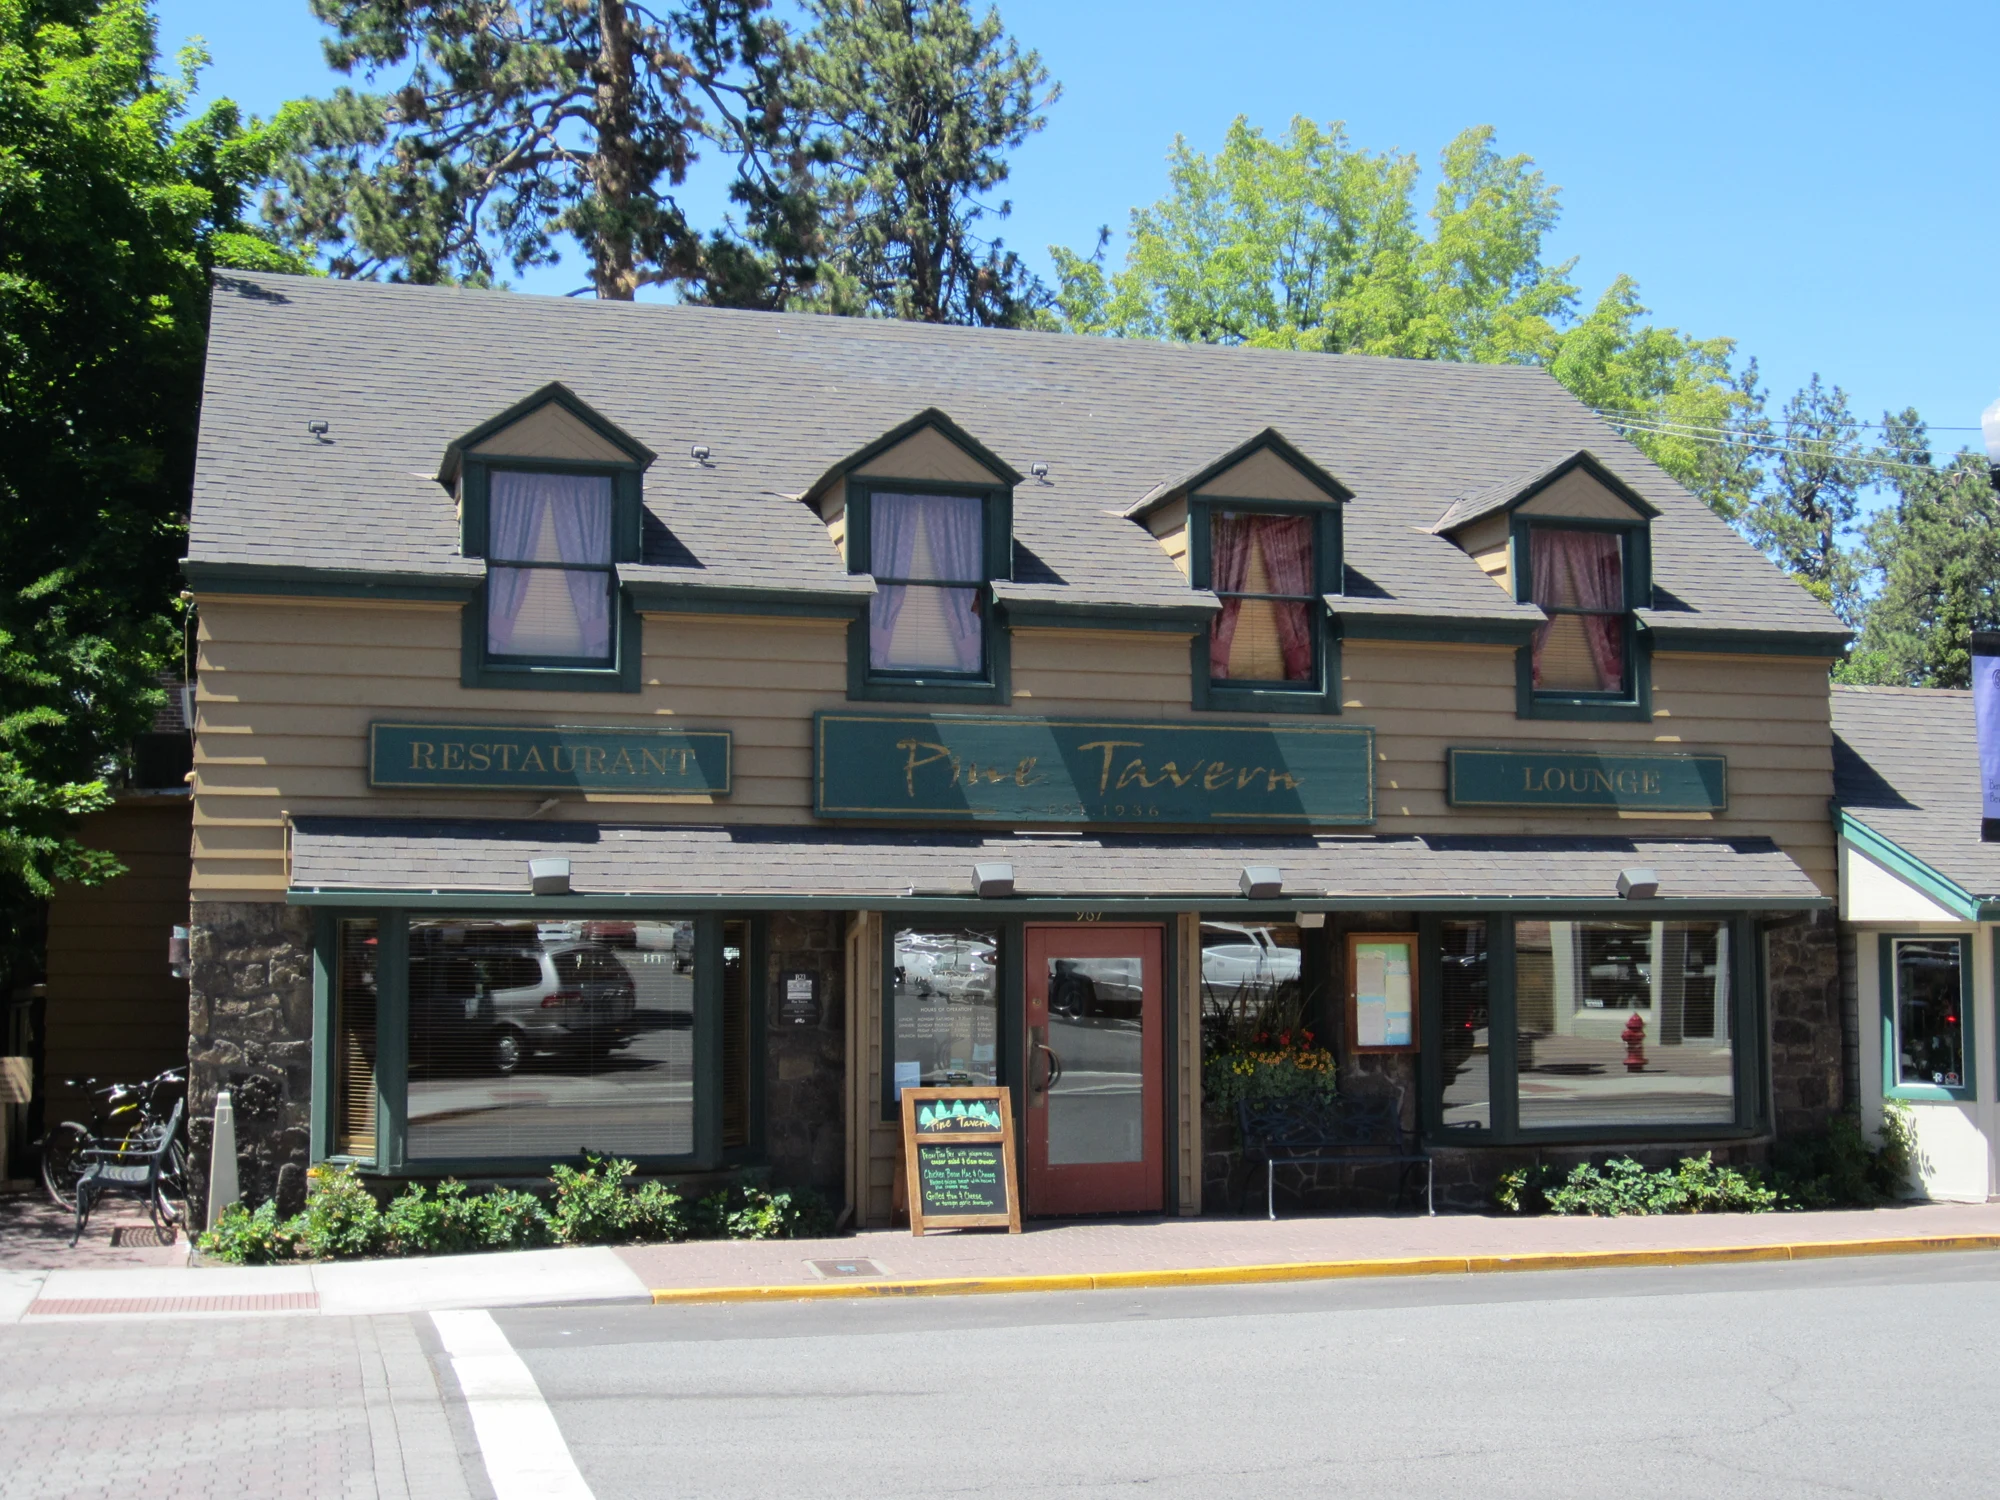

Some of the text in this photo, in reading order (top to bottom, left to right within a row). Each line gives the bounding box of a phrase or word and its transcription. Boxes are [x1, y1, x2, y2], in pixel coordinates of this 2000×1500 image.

[408, 741, 696, 776] RESTAURANT
[895, 737, 1306, 797] Pine Tavern
[1522, 766, 1661, 795] LOUNGE
[930, 1114, 990, 1132] Pine Tavern
[923, 1168, 944, 1180] Chicken
[925, 1190, 945, 1201] Grilled
[964, 1190, 982, 1200] Cheese
